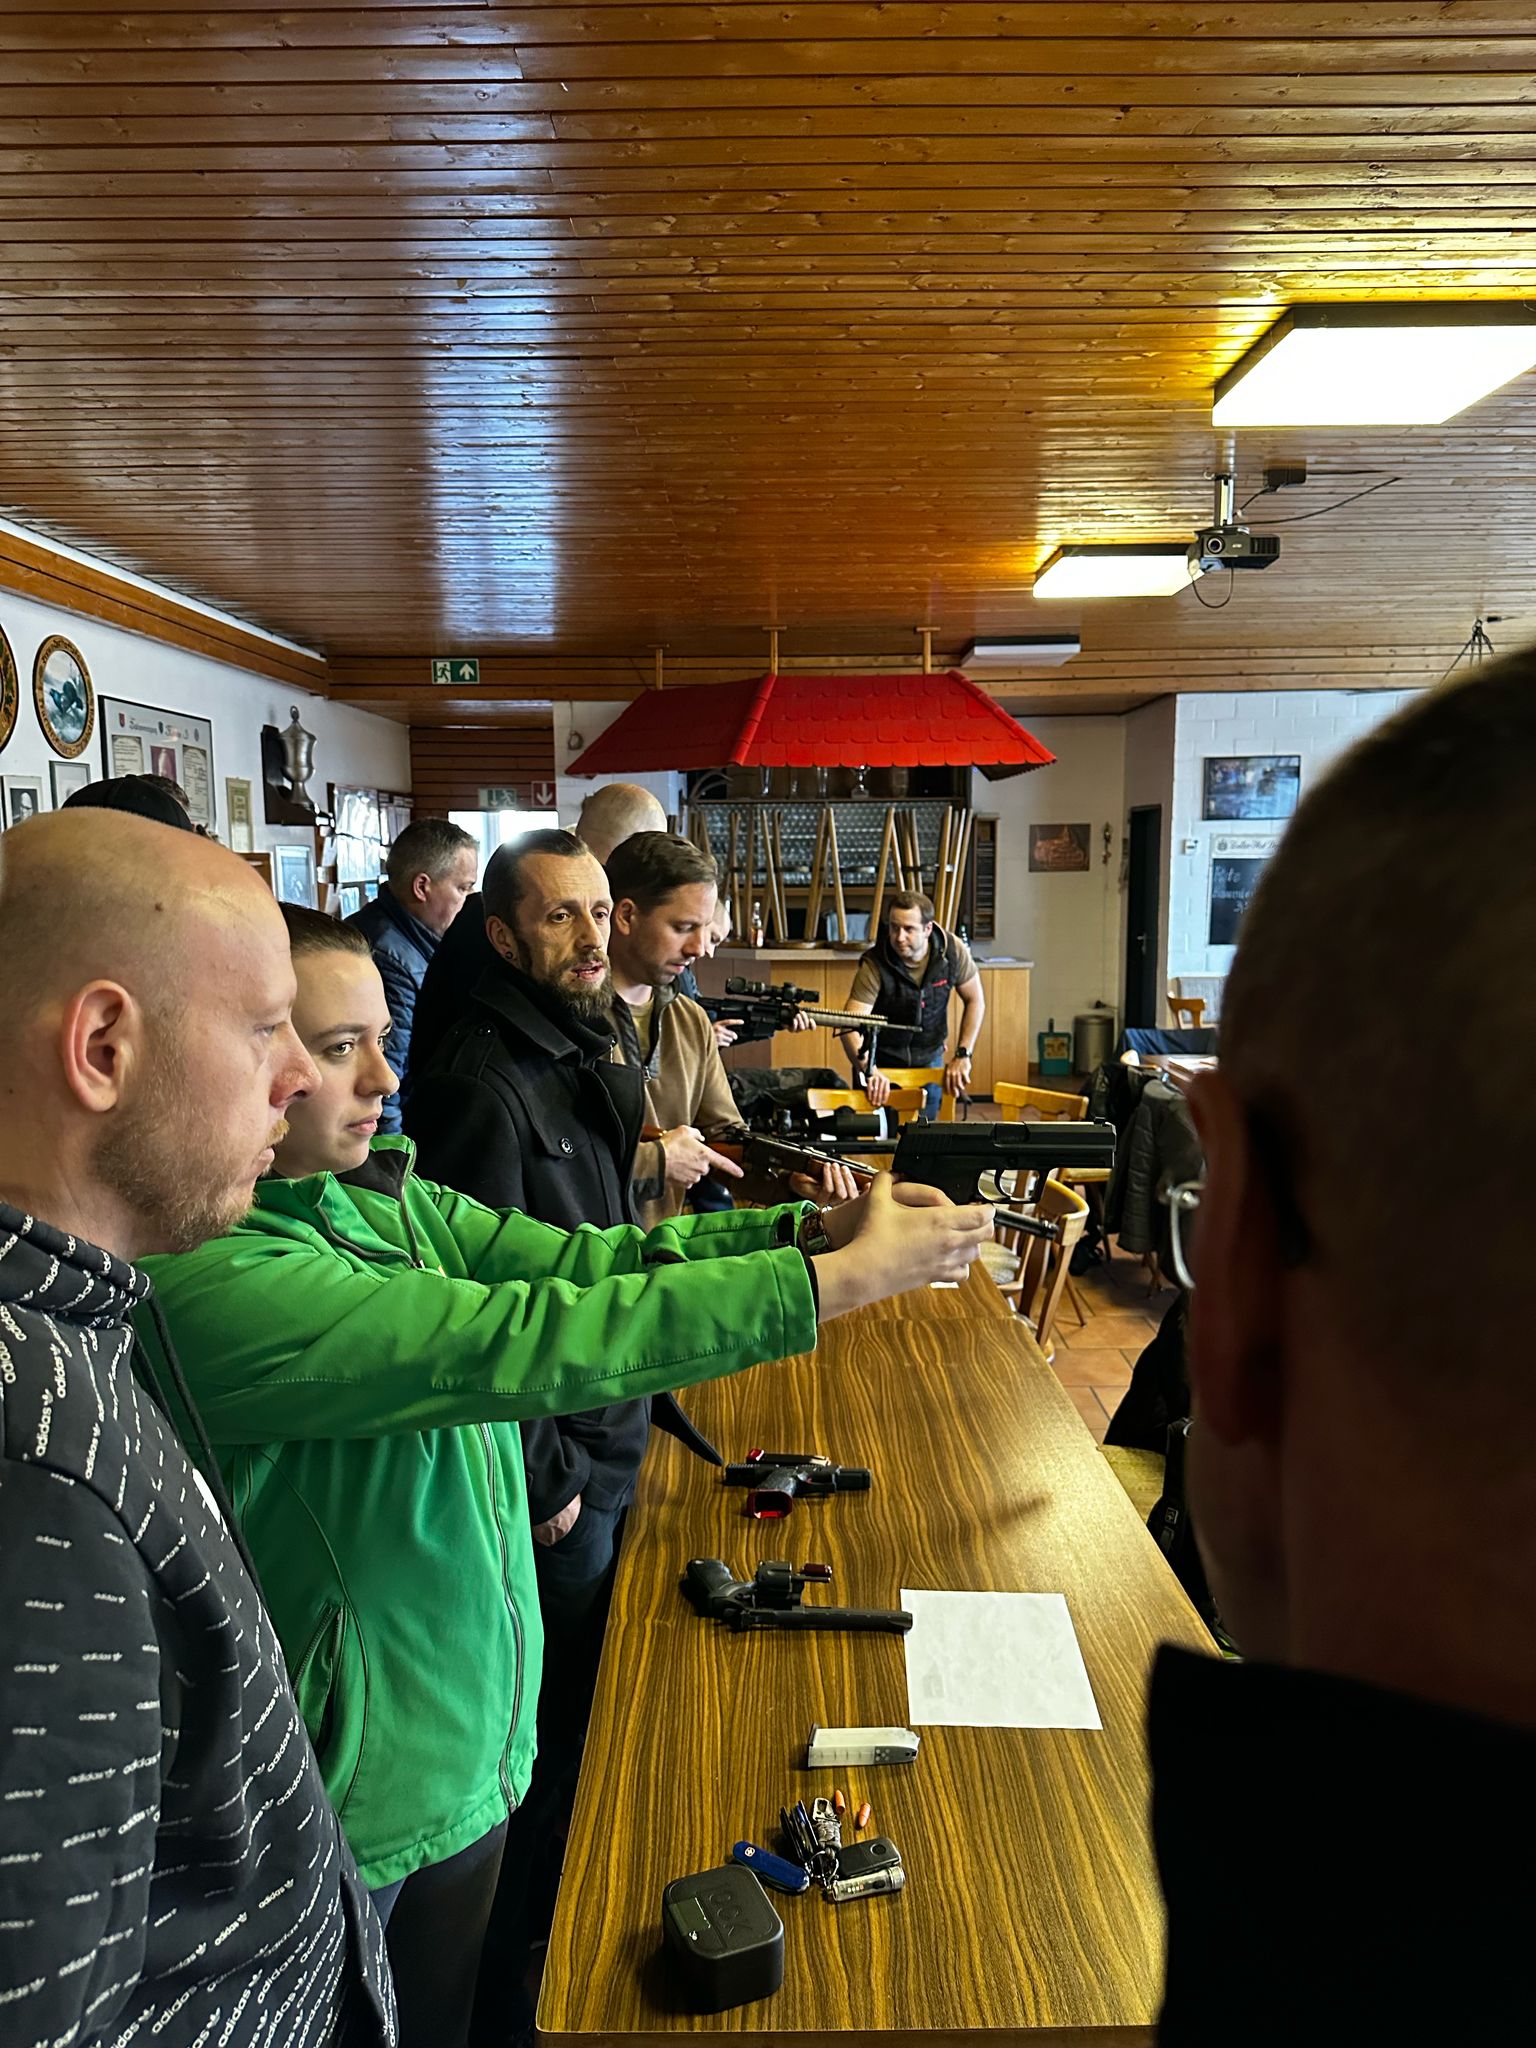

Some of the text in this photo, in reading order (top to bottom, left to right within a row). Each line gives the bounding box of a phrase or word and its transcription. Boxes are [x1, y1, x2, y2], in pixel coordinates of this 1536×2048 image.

[54, 1356, 66, 1398] adidas
[35, 1407, 52, 1456] adidas
[85, 1437, 99, 1479] adidas
[253, 1698, 276, 1732] adidas
[267, 1732, 291, 1773] adidas
[276, 1769, 305, 1806] adidas
[258, 1886, 285, 1909] adidas
[214, 1920, 240, 1946] adidas
[299, 1916, 329, 1964] adidas
[258, 1954, 296, 2004] adidas
[110, 2021, 140, 2048] idas
[218, 1989, 251, 2048] adidas
[264, 1992, 296, 2048] adidas
